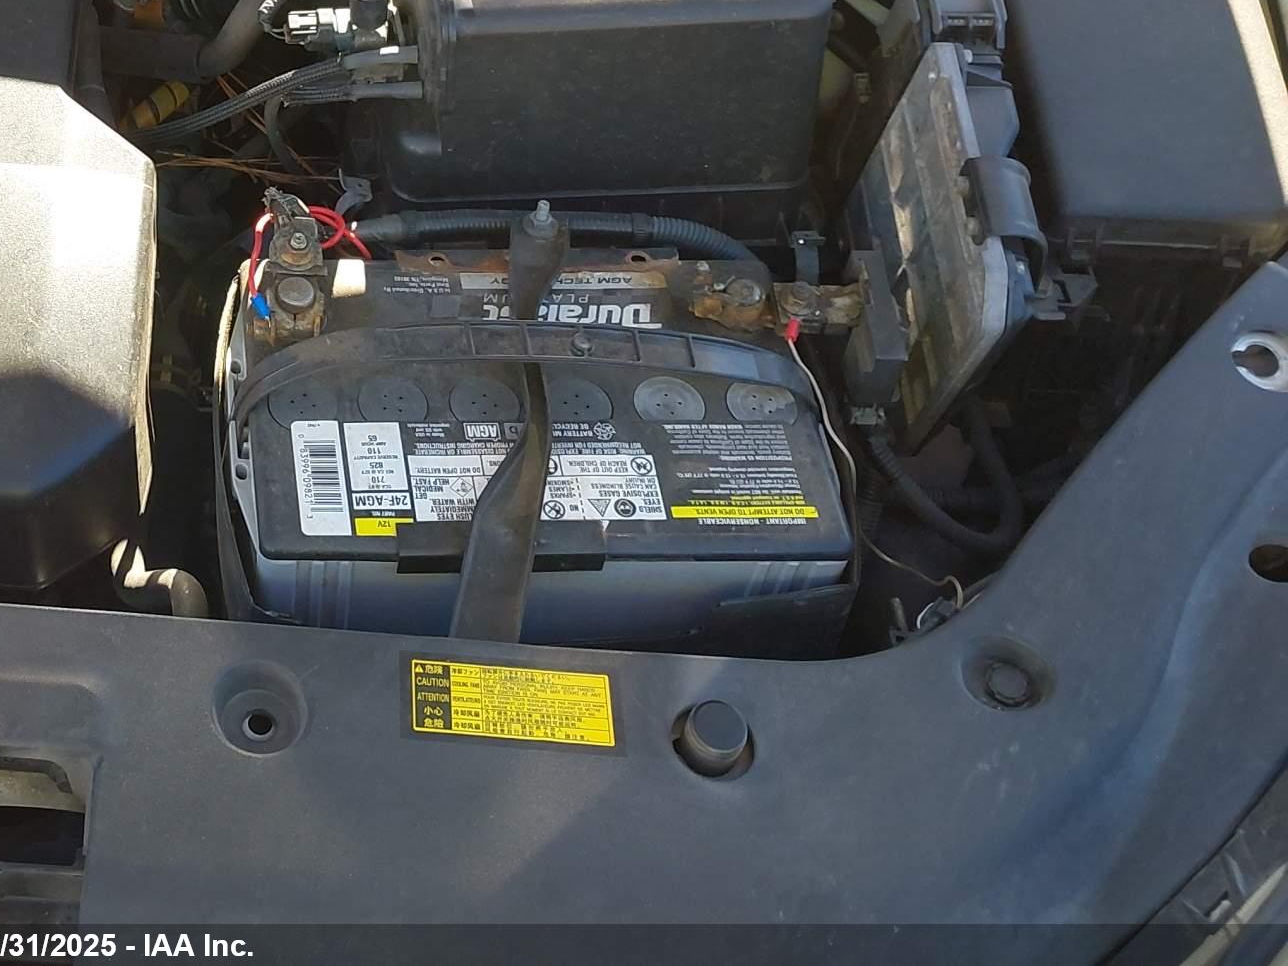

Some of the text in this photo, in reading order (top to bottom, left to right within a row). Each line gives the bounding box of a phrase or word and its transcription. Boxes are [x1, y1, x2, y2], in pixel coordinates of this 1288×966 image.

[598, 277, 632, 285] AGM
[467, 424, 497, 438] AGM
[414, 466, 441, 474] BATTERY.
[412, 478, 450, 486] HELP FAST.
[413, 485, 444, 493] MEDICAL
[415, 492, 427, 500] GET
[355, 495, 408, 507] 24F-AGM
[428, 498, 475, 506] WITH WATER.
[430, 505, 473, 513] MMEDIATELY
[638, 505, 662, 513] SHIELD
[455, 513, 472, 521] LUSH
[377, 520, 391, 528] 12V
[416, 676, 449, 688] CAUTION
[417, 692, 449, 703] ATTENTION
[423, 705, 443, 716] 小心
